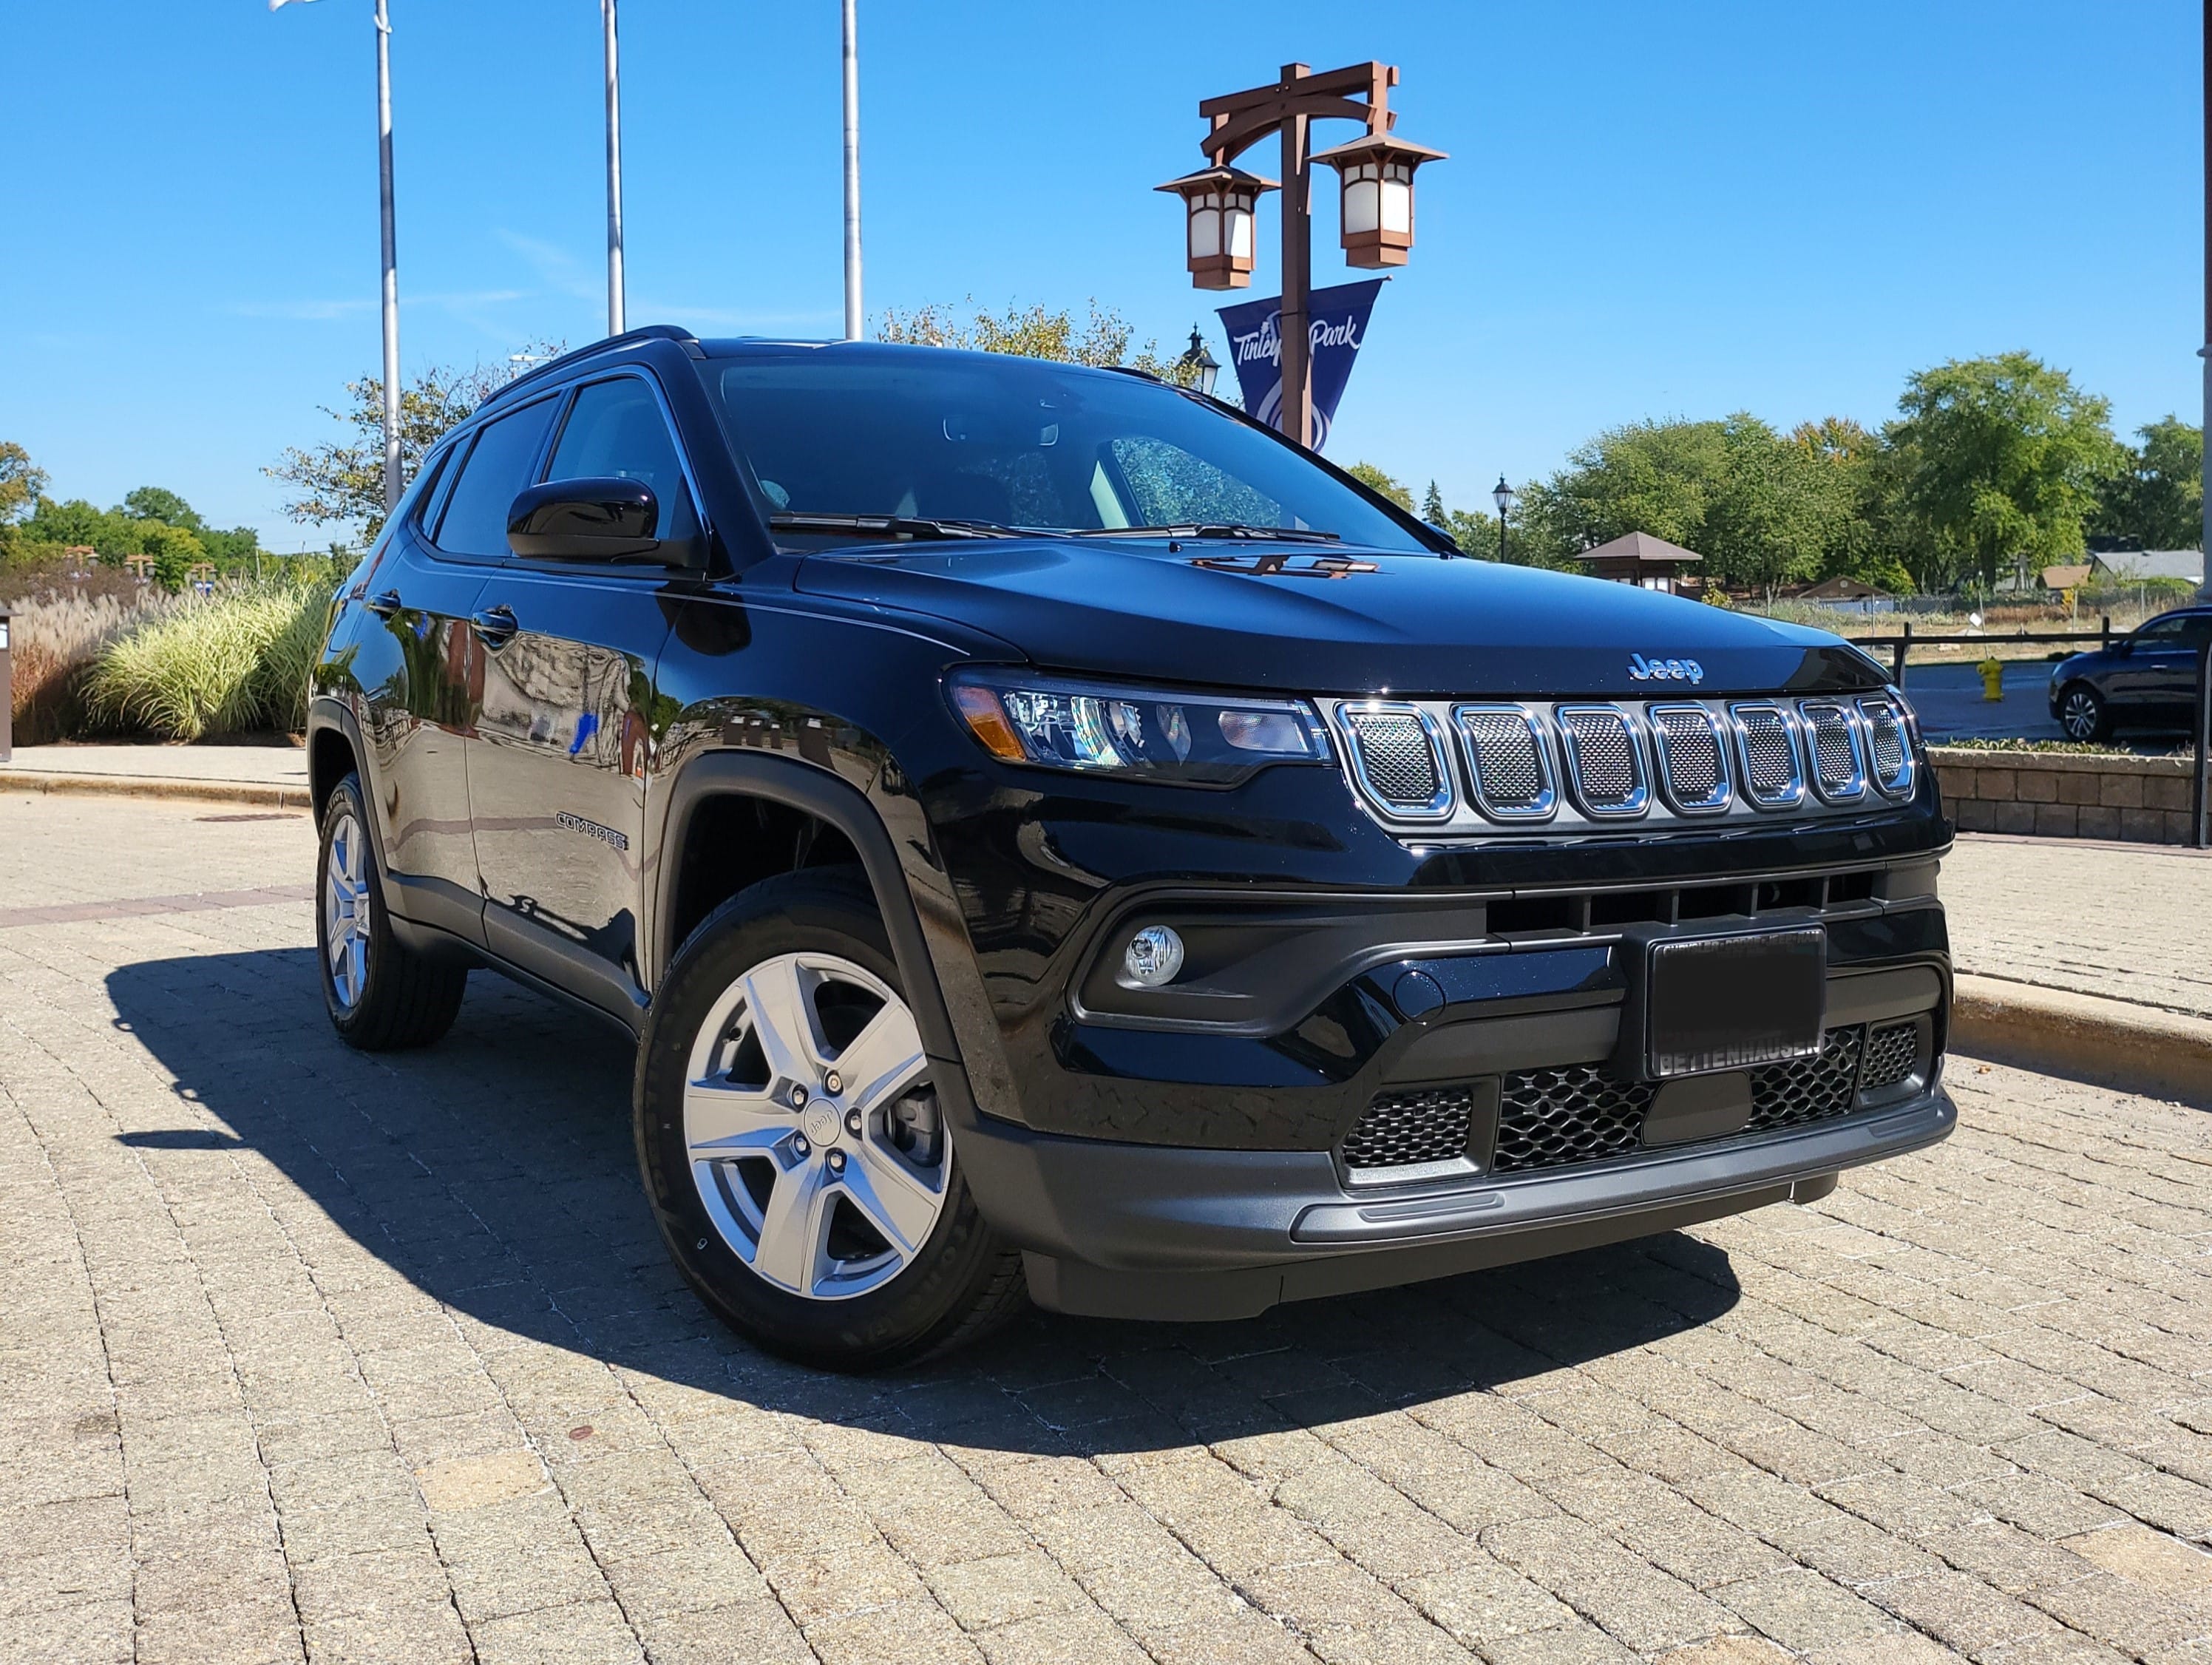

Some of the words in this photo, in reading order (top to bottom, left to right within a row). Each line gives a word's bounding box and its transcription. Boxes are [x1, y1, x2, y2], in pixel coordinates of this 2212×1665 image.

[1232, 322, 1283, 367] Tinley
[1309, 315, 1360, 356] Park
[1627, 653, 1703, 685] Jeep
[555, 811, 628, 850] COMPASS
[810, 1110, 833, 1136] Jeep
